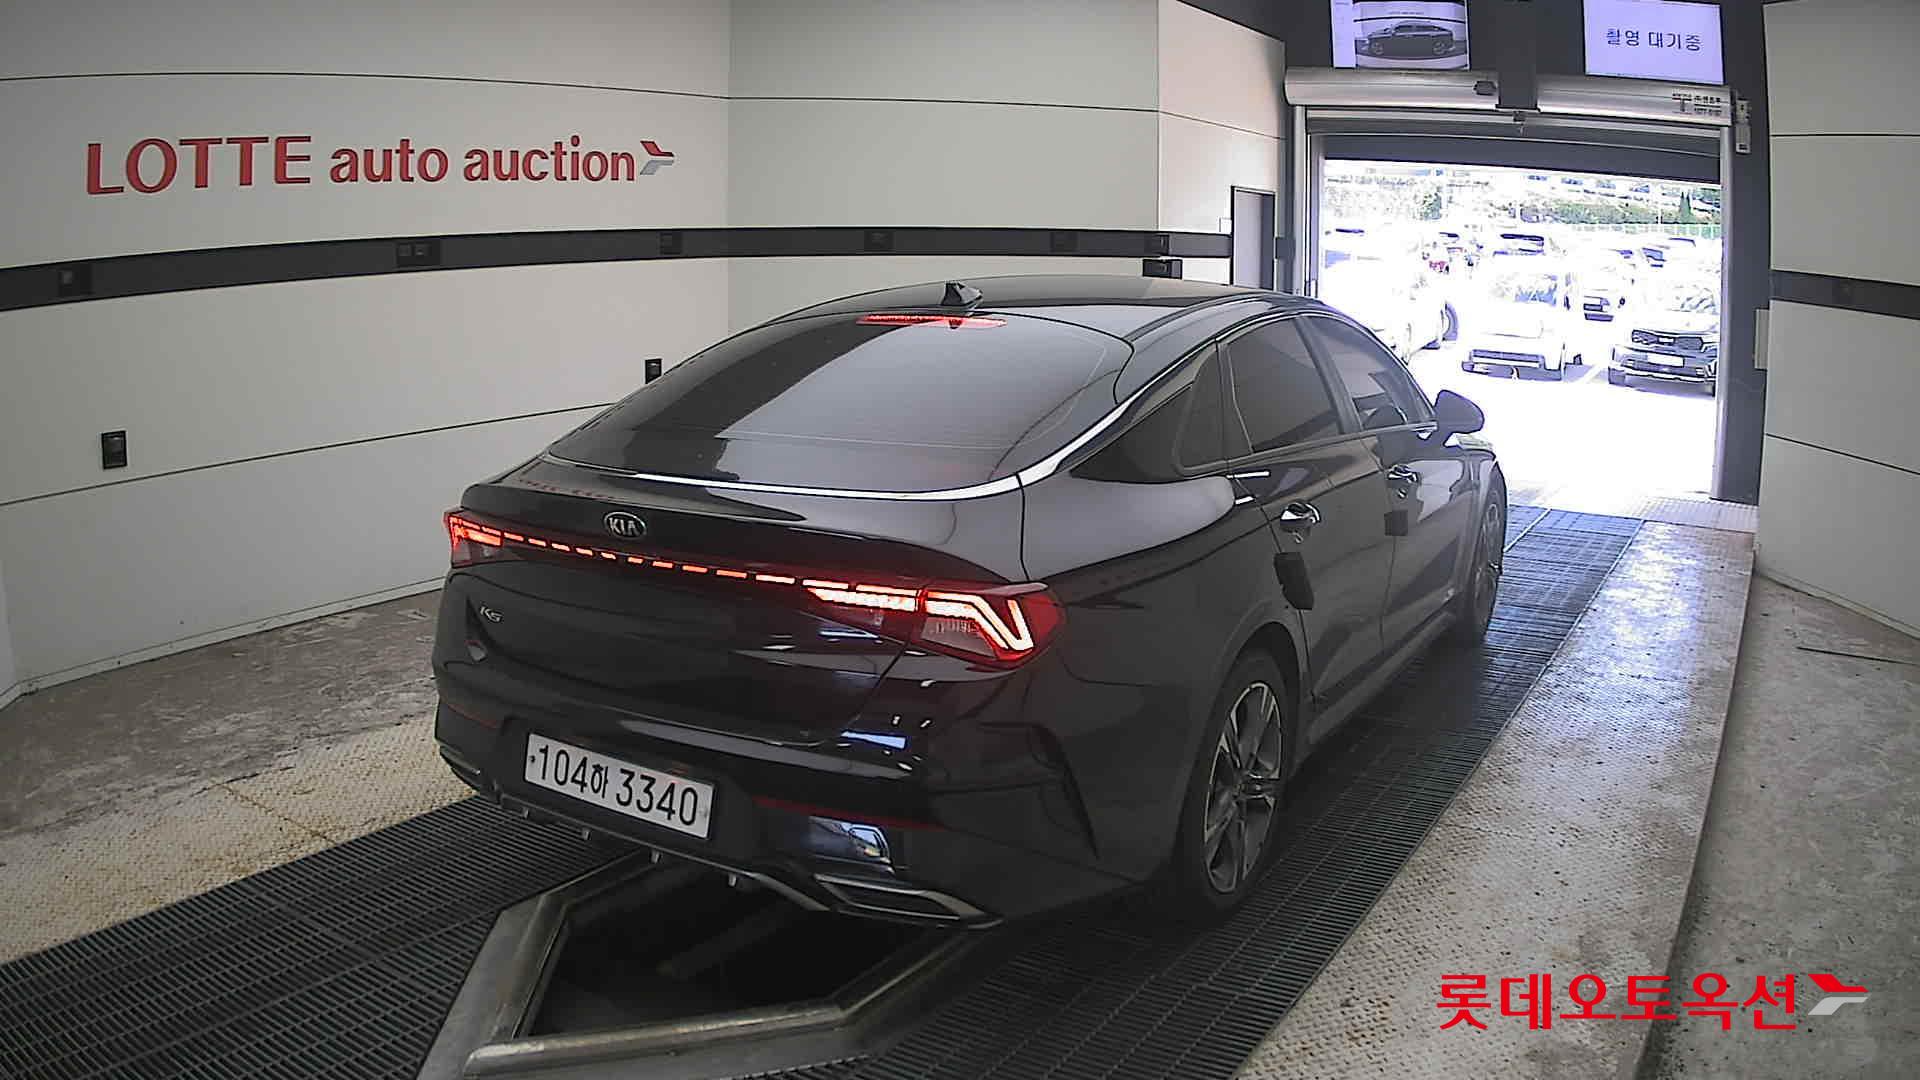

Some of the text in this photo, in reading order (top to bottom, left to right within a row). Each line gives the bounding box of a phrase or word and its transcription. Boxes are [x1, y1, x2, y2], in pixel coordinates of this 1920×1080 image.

[1648, 31, 1702, 52] 대기중
[86, 135, 635, 195] LOTTE auto auction
[608, 516, 641, 537] KIA
[539, 744, 698, 826] 104하 3340
